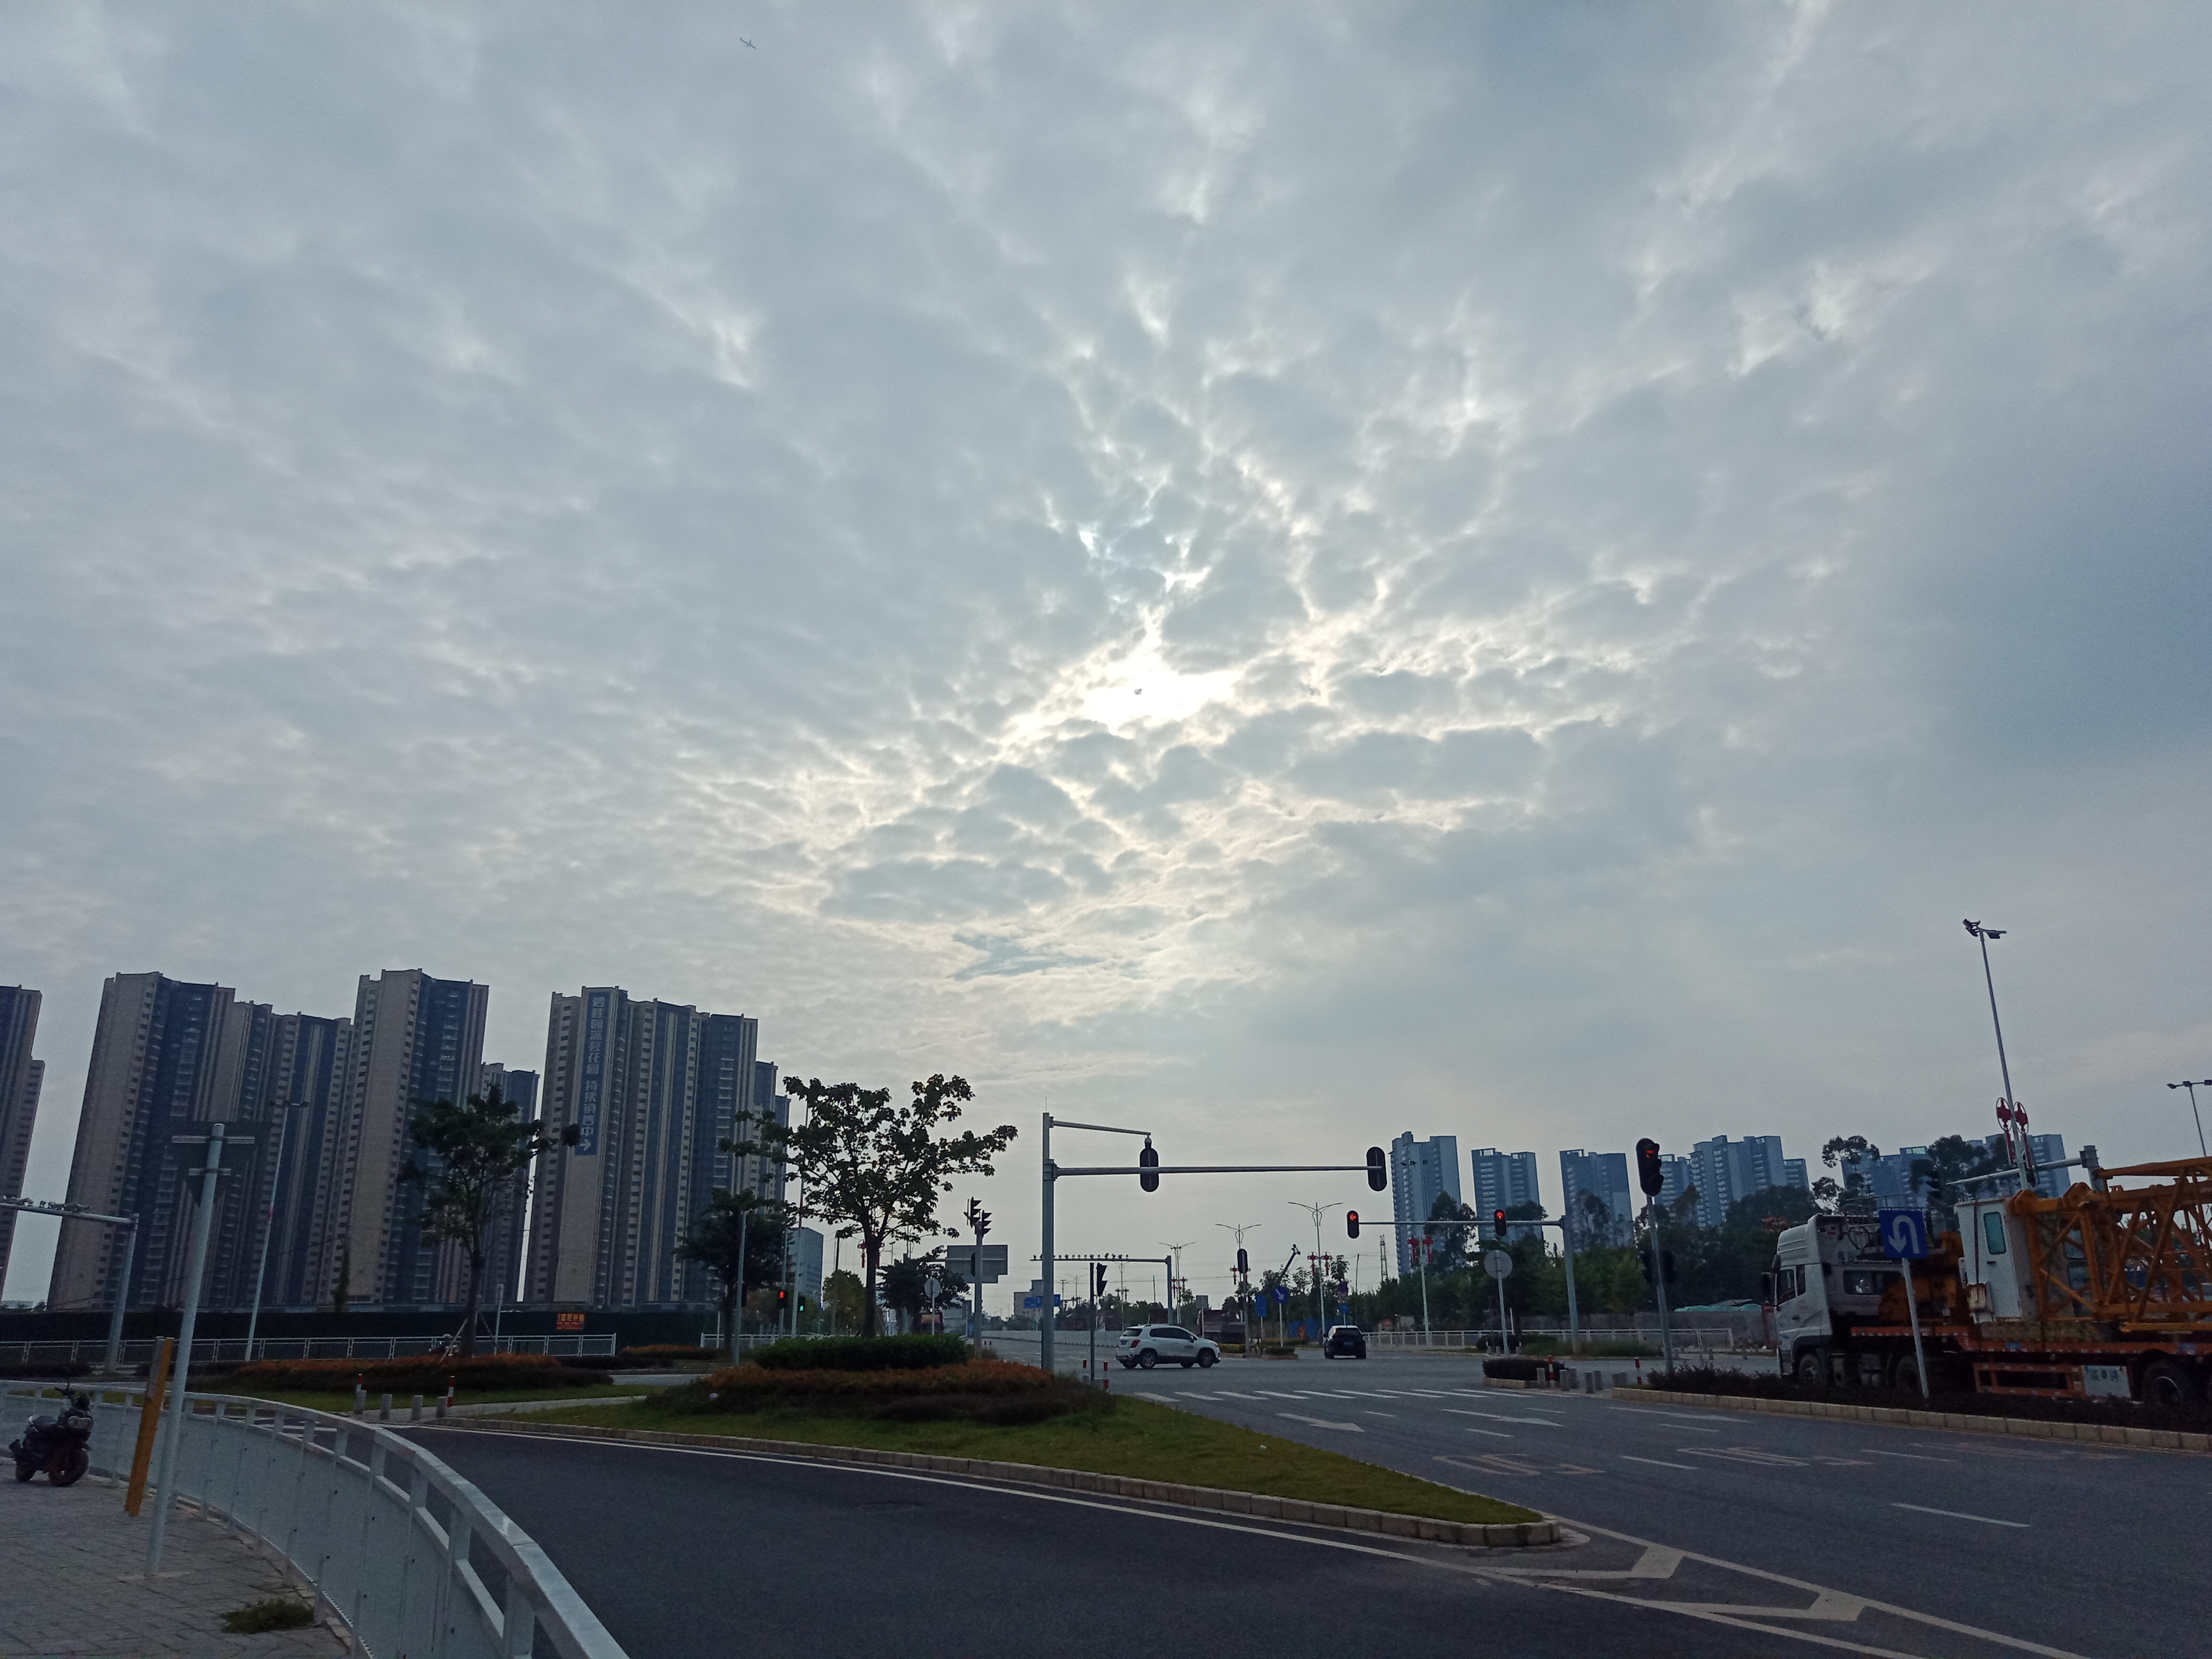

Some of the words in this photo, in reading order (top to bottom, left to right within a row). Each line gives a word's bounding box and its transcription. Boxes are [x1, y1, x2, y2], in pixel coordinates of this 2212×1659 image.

[581, 1080, 598, 1136] 持续销售中
